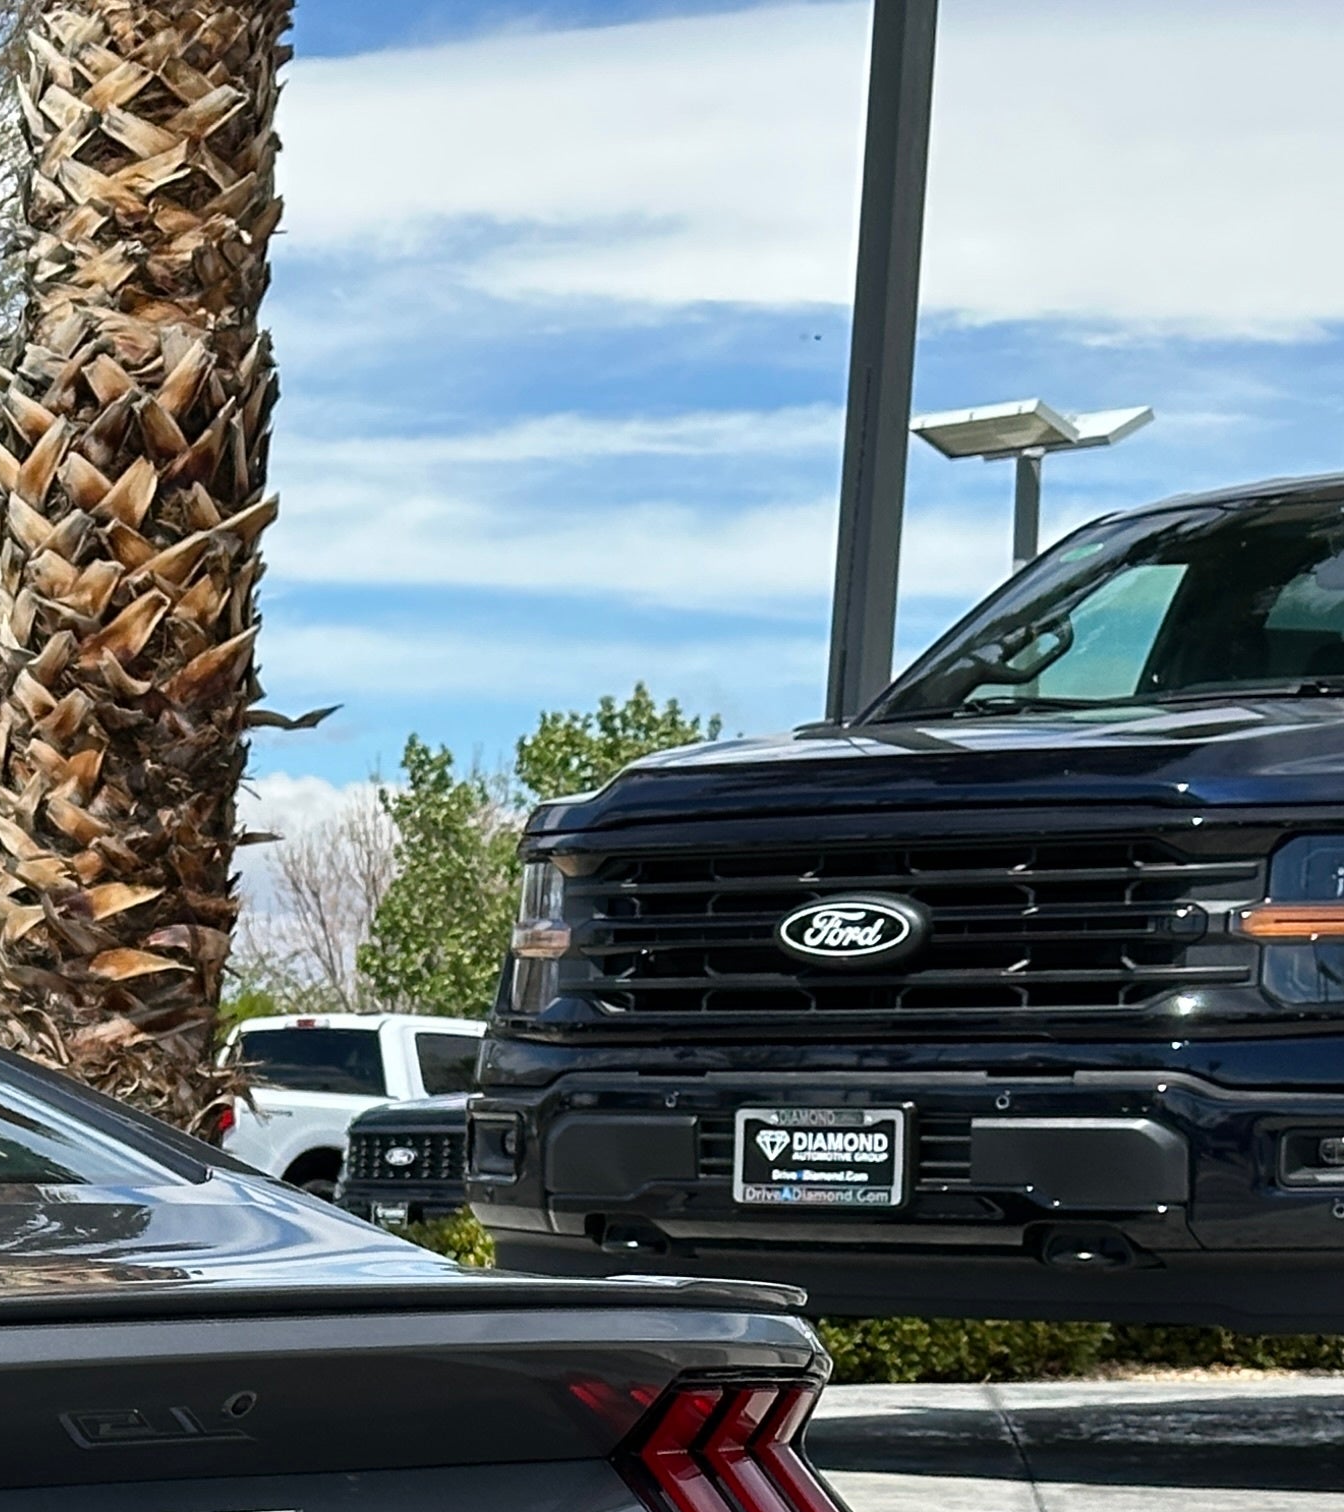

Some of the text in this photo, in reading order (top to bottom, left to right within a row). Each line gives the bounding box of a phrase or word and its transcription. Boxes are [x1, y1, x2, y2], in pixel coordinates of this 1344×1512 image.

[804, 909, 884, 948] Ford
[777, 1110, 835, 1125] DIAMOND
[792, 1132, 889, 1152] DIAMOND
[854, 1152, 889, 1163] GROUP
